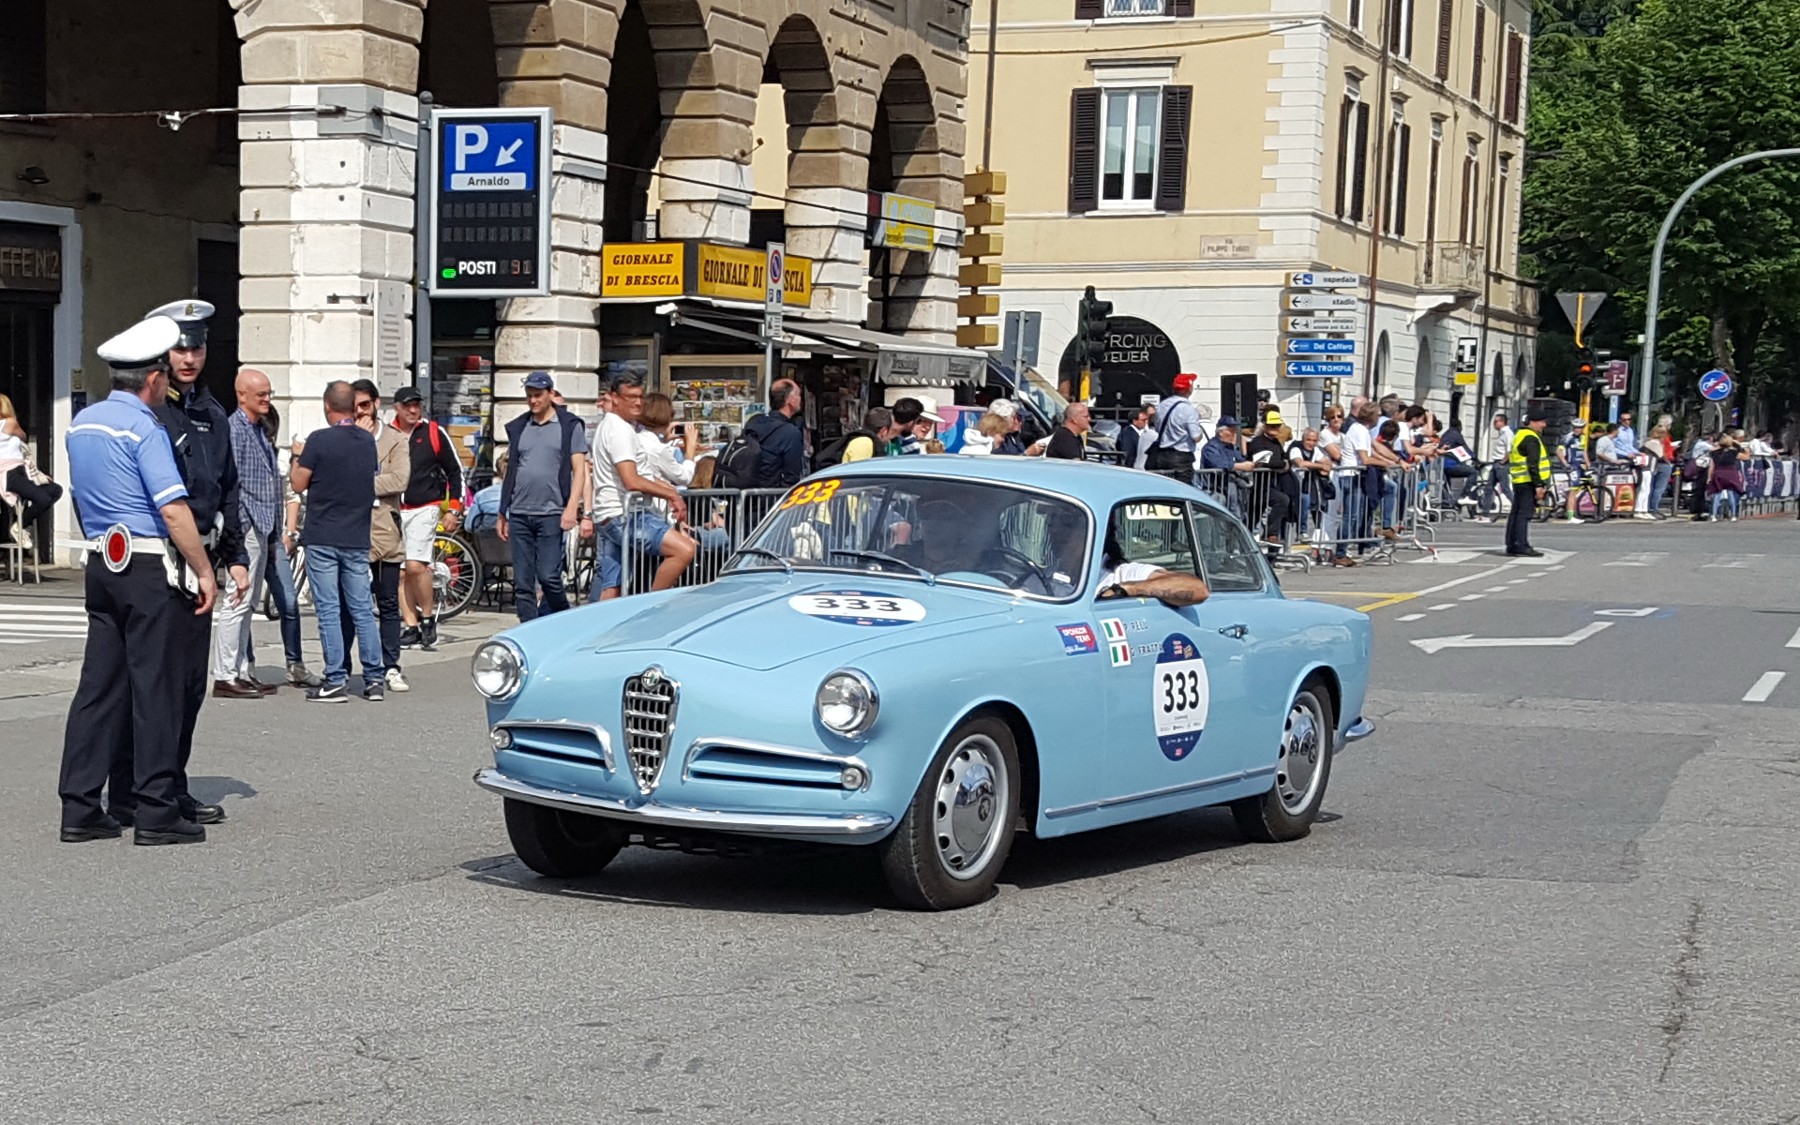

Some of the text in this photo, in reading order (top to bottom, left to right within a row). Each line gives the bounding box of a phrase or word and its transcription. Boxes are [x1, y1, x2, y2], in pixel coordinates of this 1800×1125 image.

[455, 125, 489, 171] P
[467, 176, 510, 186] Arnaldo
[613, 254, 674, 265] GIORNALE
[458, 261, 496, 275] POSTI
[606, 274, 680, 286] DI BRESCIA
[703, 259, 804, 293] GIORNALE DI SCIA
[1332, 298, 1355, 306] stadio
[1104, 333, 1167, 348] RCING
[1103, 351, 1150, 362] TELIER
[780, 479, 842, 510] 333
[813, 598, 902, 612] 333
[1062, 627, 1088, 637] SPONSOR
[1075, 634, 1091, 643] TEAM
[1163, 670, 1200, 713] 333
